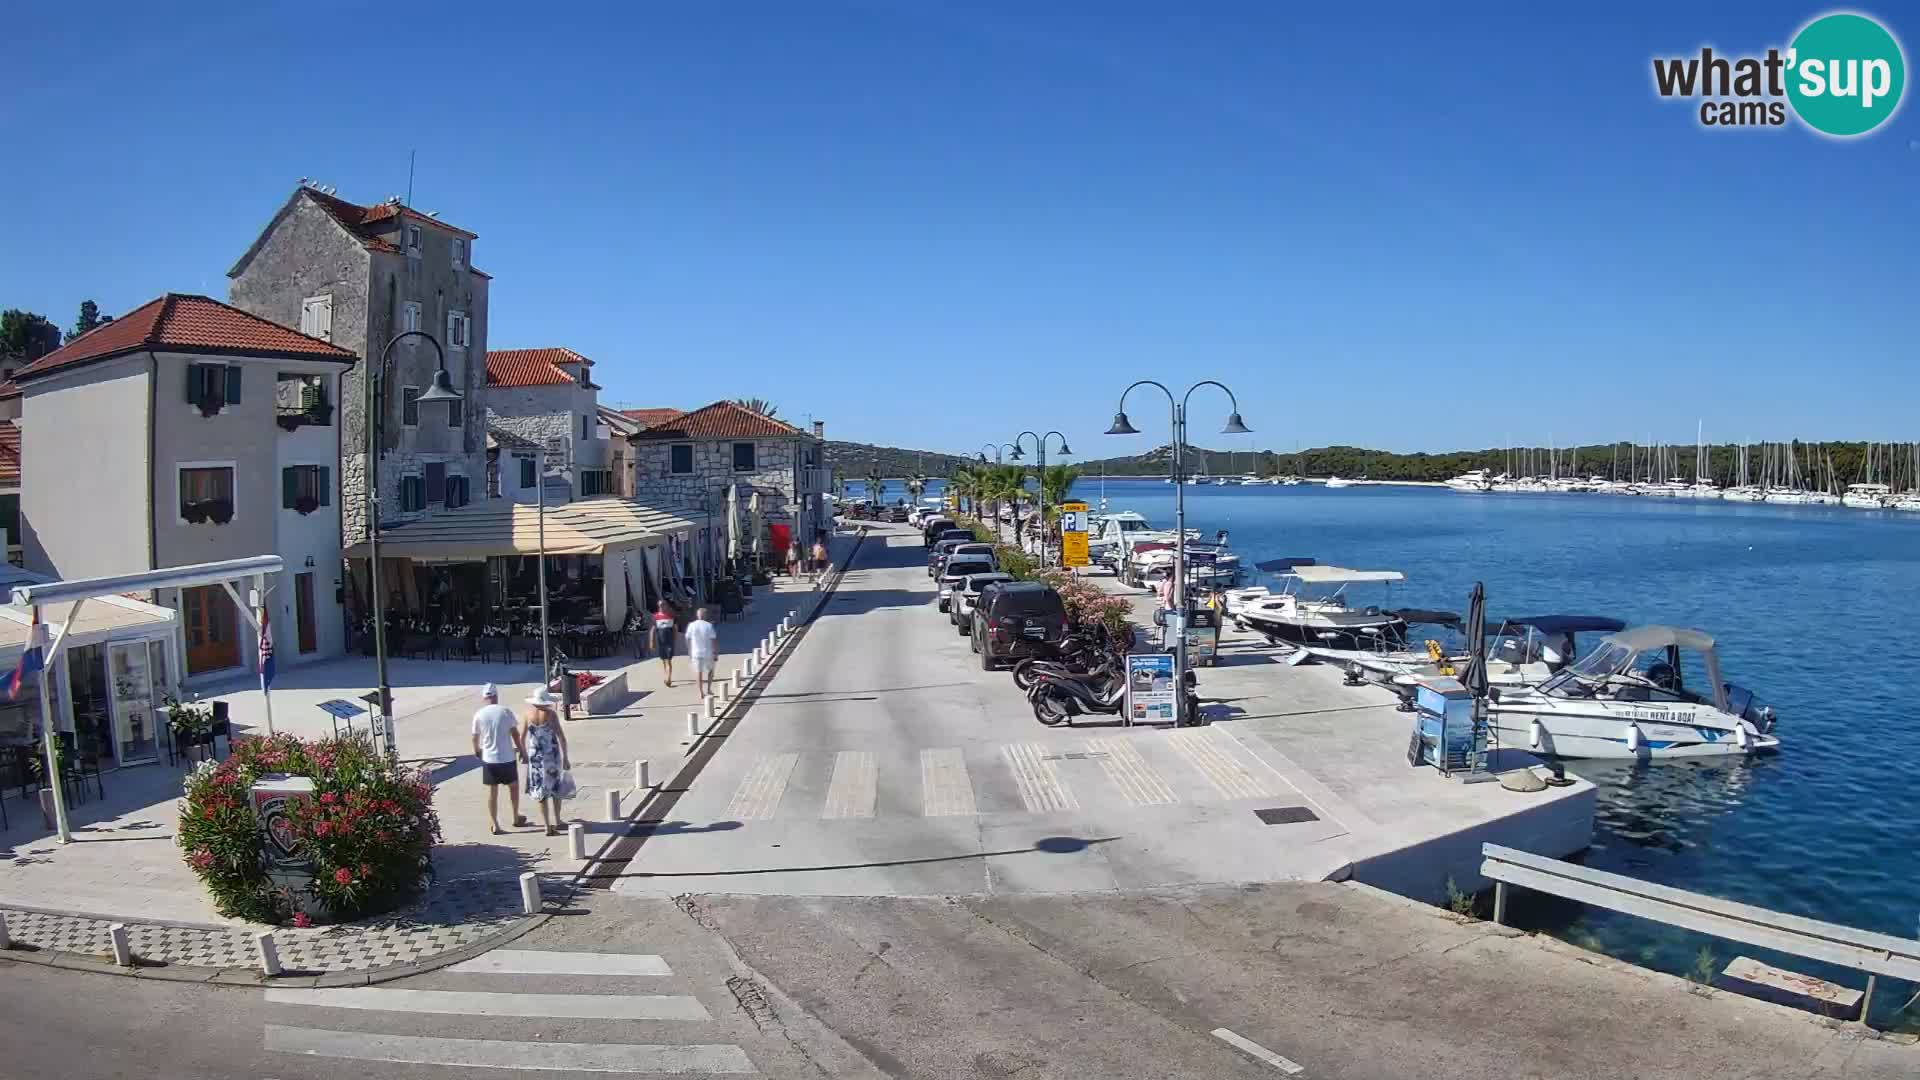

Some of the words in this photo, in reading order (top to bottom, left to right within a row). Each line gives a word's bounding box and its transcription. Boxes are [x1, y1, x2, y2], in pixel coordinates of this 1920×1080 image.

[1650, 711, 1669, 720] RENT
[1670, 712, 1676, 721] A
[1677, 712, 1696, 723] BOAT
